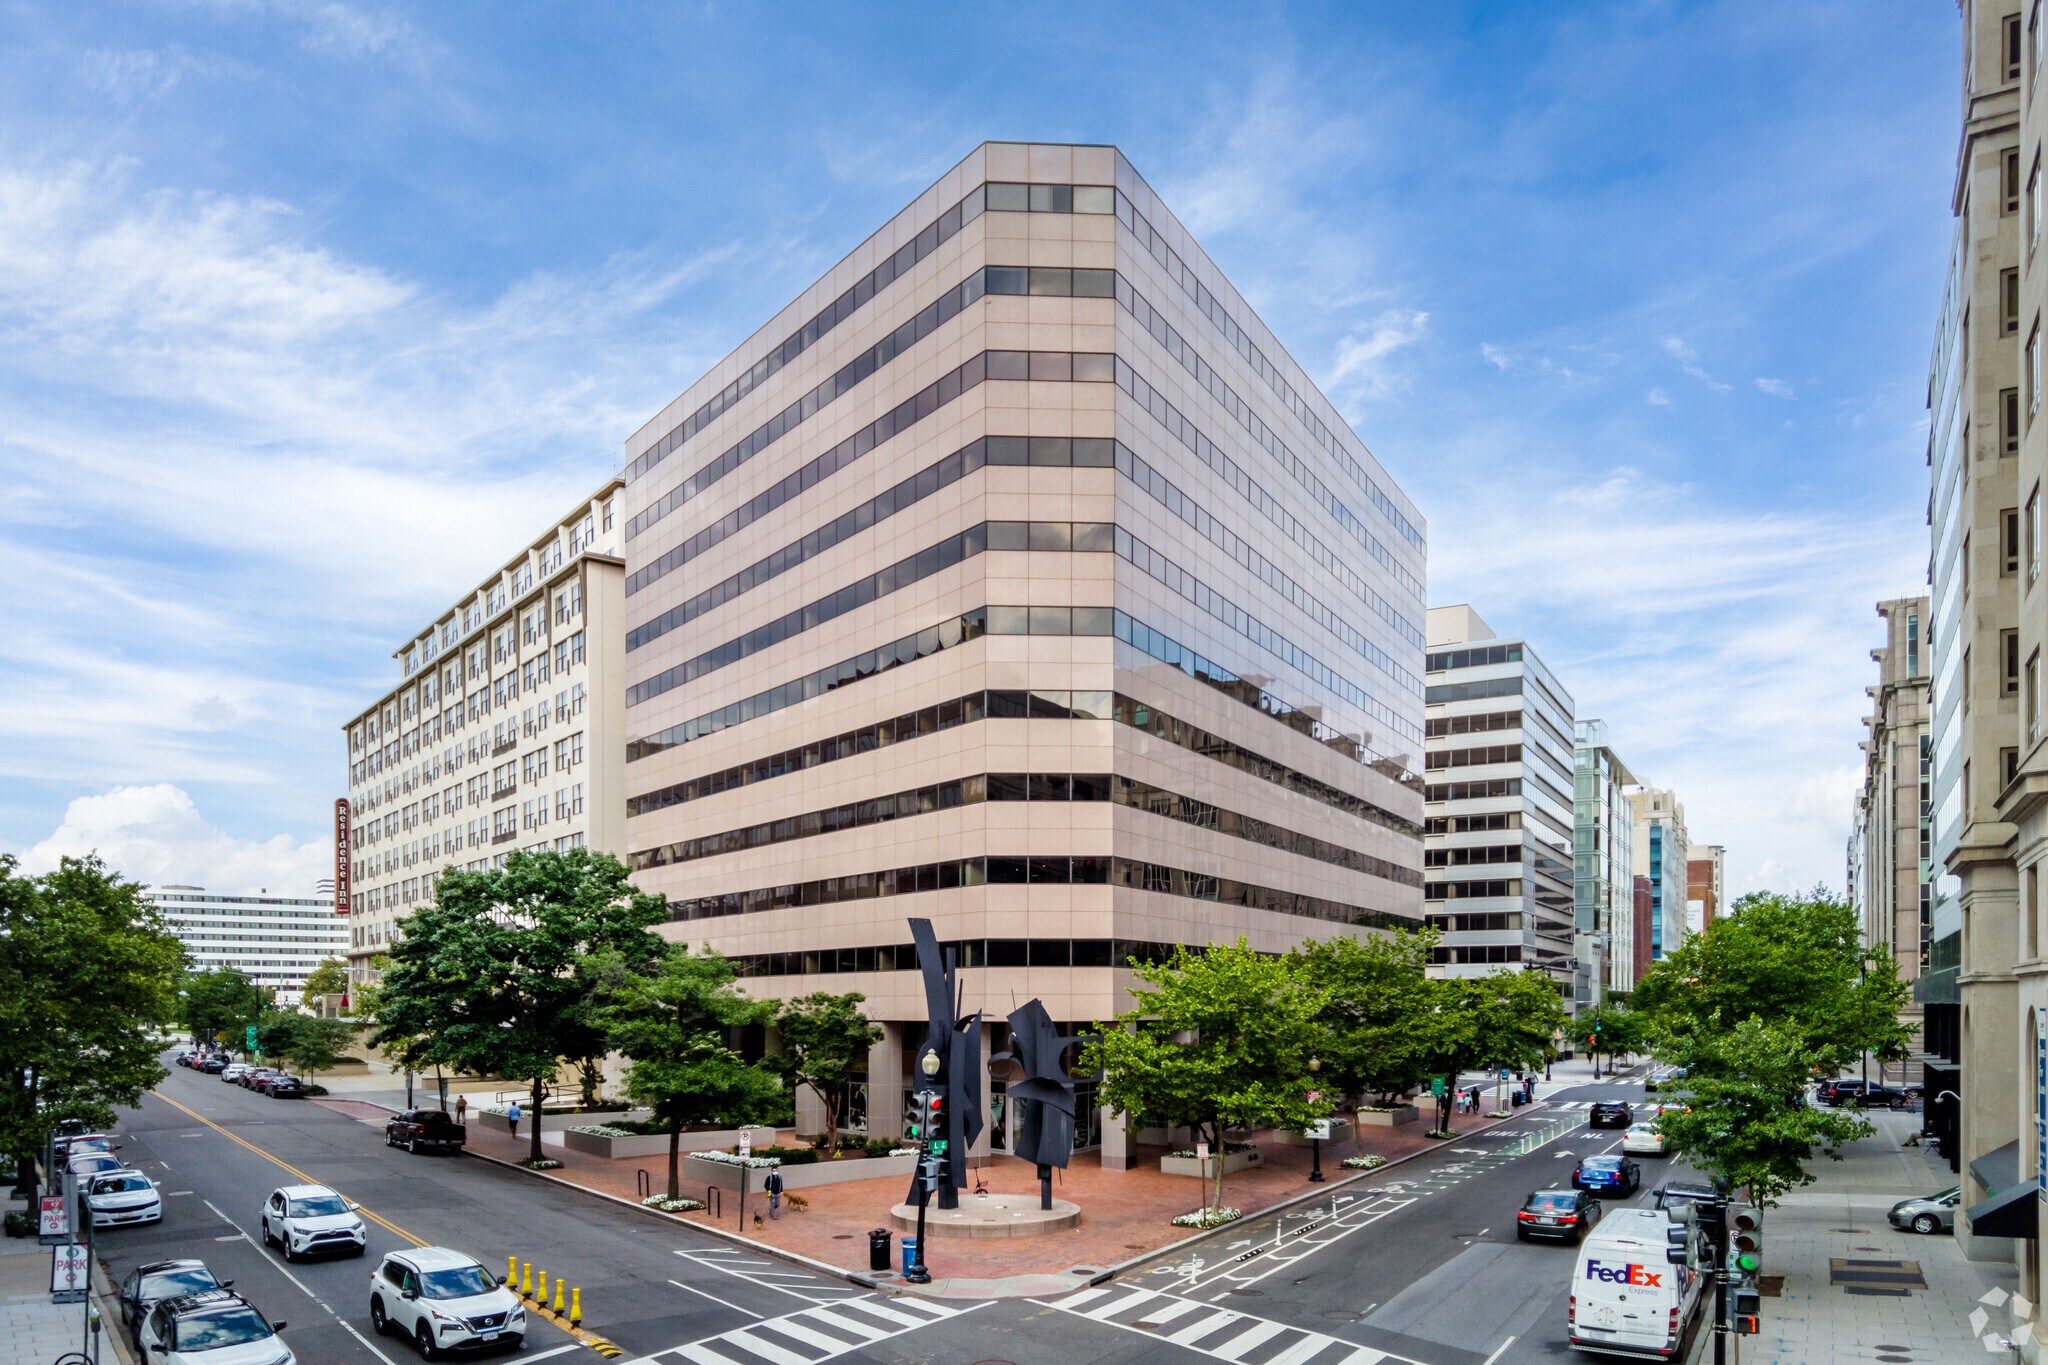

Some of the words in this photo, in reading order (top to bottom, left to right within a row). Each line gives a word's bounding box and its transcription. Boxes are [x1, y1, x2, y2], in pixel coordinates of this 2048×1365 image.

[338, 806, 347, 878] Residence
[339, 881, 347, 904] Inn
[56, 1260, 87, 1271] PARK
[1586, 1259, 1662, 1288] FedEx
[1628, 1286, 1659, 1297] Express
